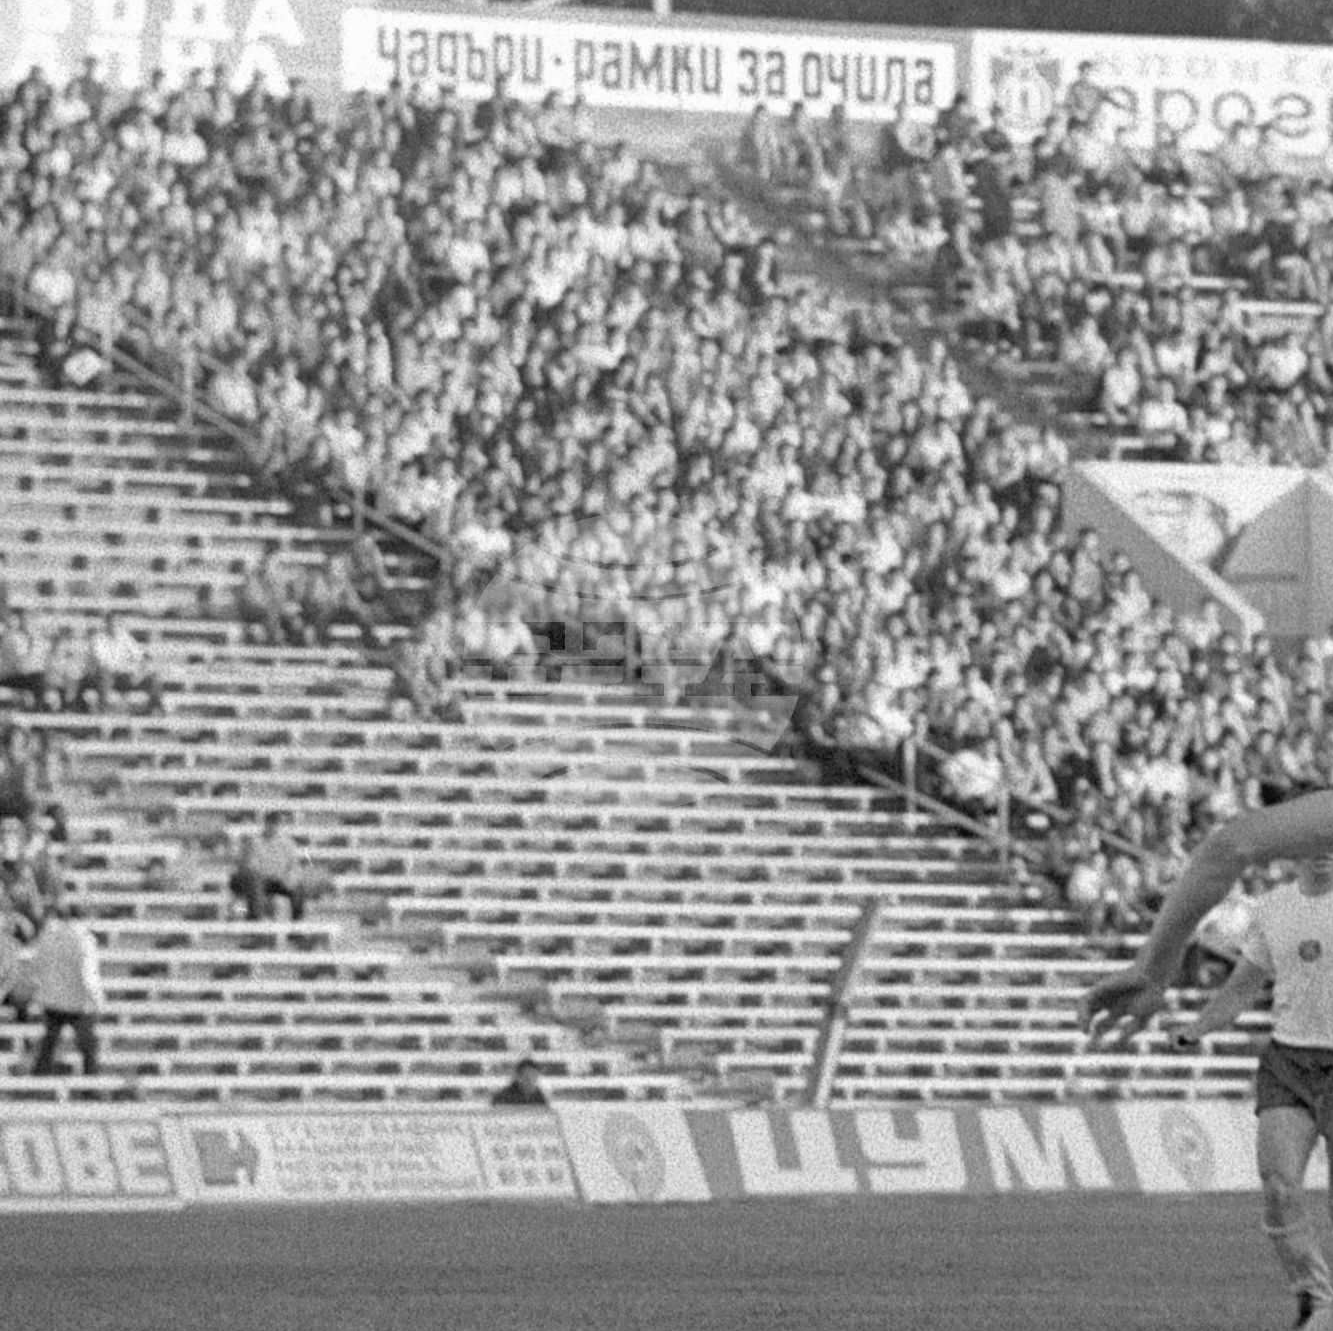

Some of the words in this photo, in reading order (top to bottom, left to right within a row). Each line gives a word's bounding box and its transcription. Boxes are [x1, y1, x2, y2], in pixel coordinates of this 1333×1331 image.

[573, 38, 722, 98] рамки
[736, 47, 788, 99] за
[800, 49, 936, 107] очила
[0, 1122, 171, 1195] ОВЕ
[728, 1106, 1114, 1195] ЦУМ
